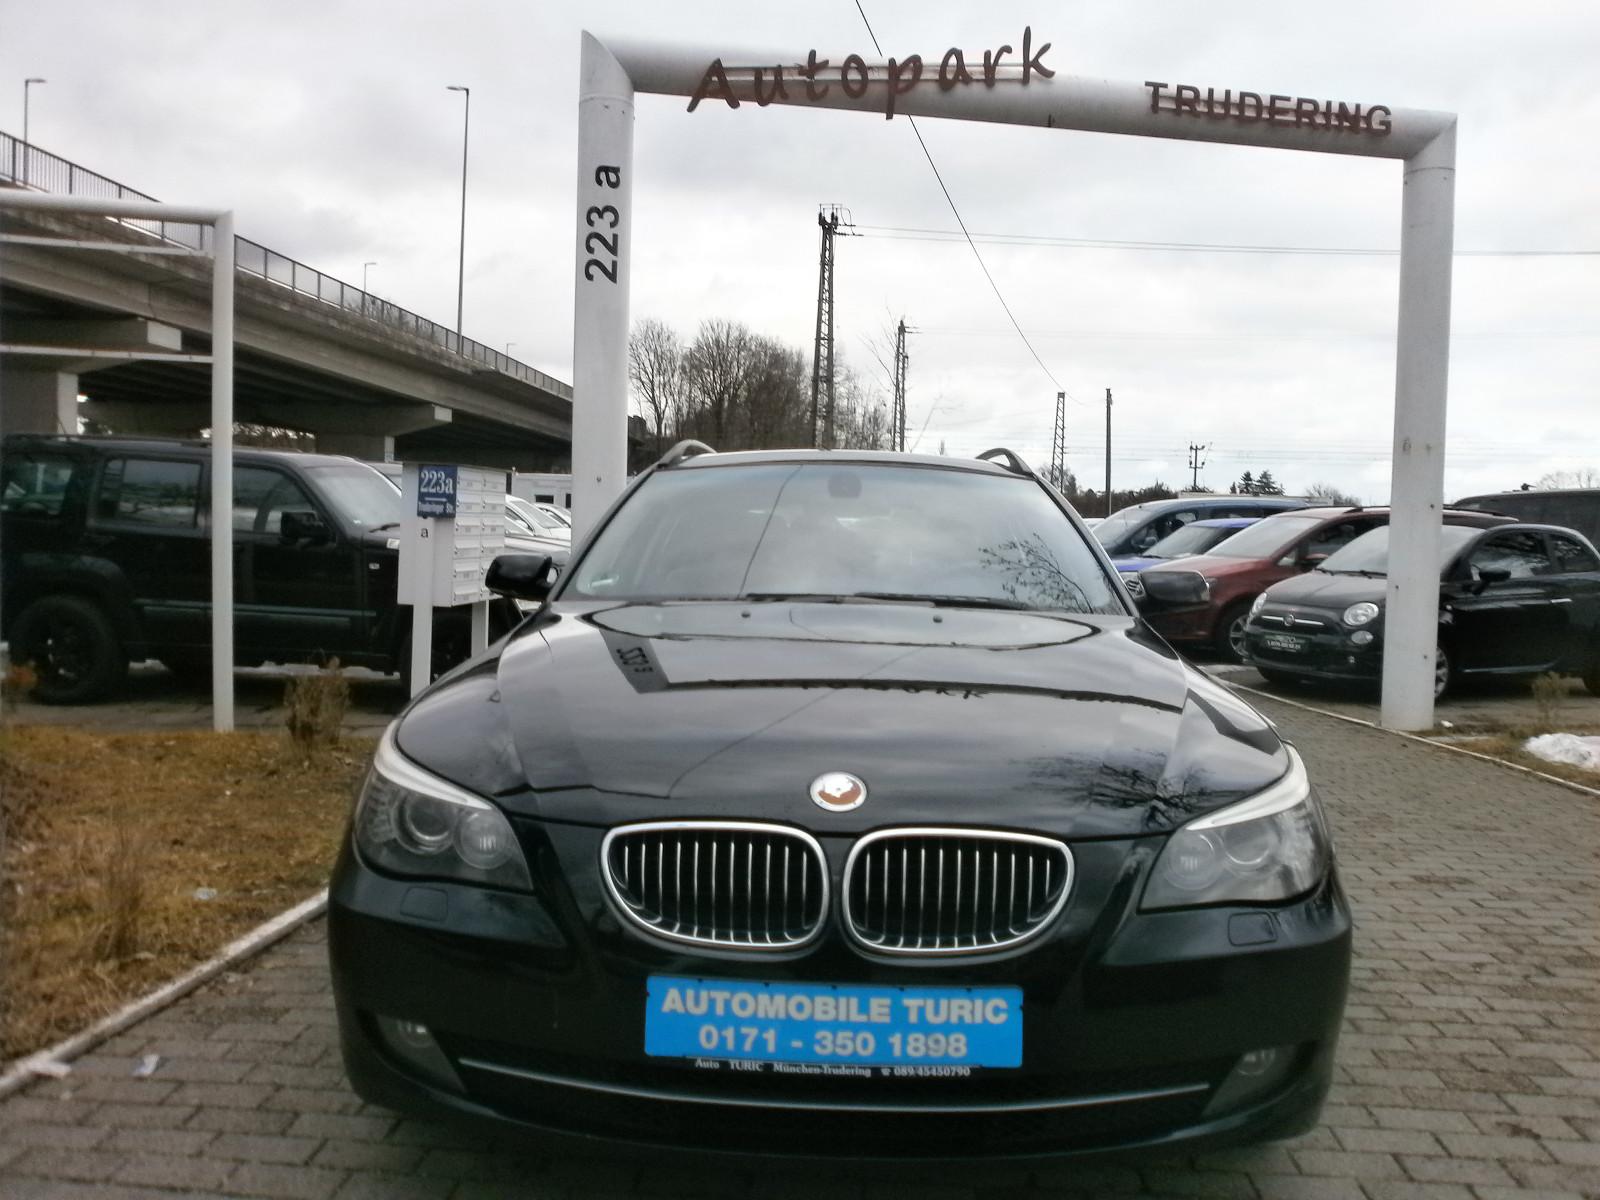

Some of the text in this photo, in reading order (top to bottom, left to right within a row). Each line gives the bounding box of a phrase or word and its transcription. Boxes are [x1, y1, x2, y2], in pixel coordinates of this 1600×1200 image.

[686, 25, 1056, 120] Autopark
[1144, 80, 1392, 136] TRUDERING
[584, 164, 621, 284] 223 a
[420, 470, 454, 494] 223a
[420, 528, 429, 539] a
[661, 987, 1009, 1025] AUTOMOBILE TURIC
[698, 1024, 777, 1053] 0171
[813, 1031, 876, 1057] 350
[888, 1033, 968, 1059] 1898
[694, 1057, 720, 1070] Auto
[728, 1059, 765, 1072] TURIC
